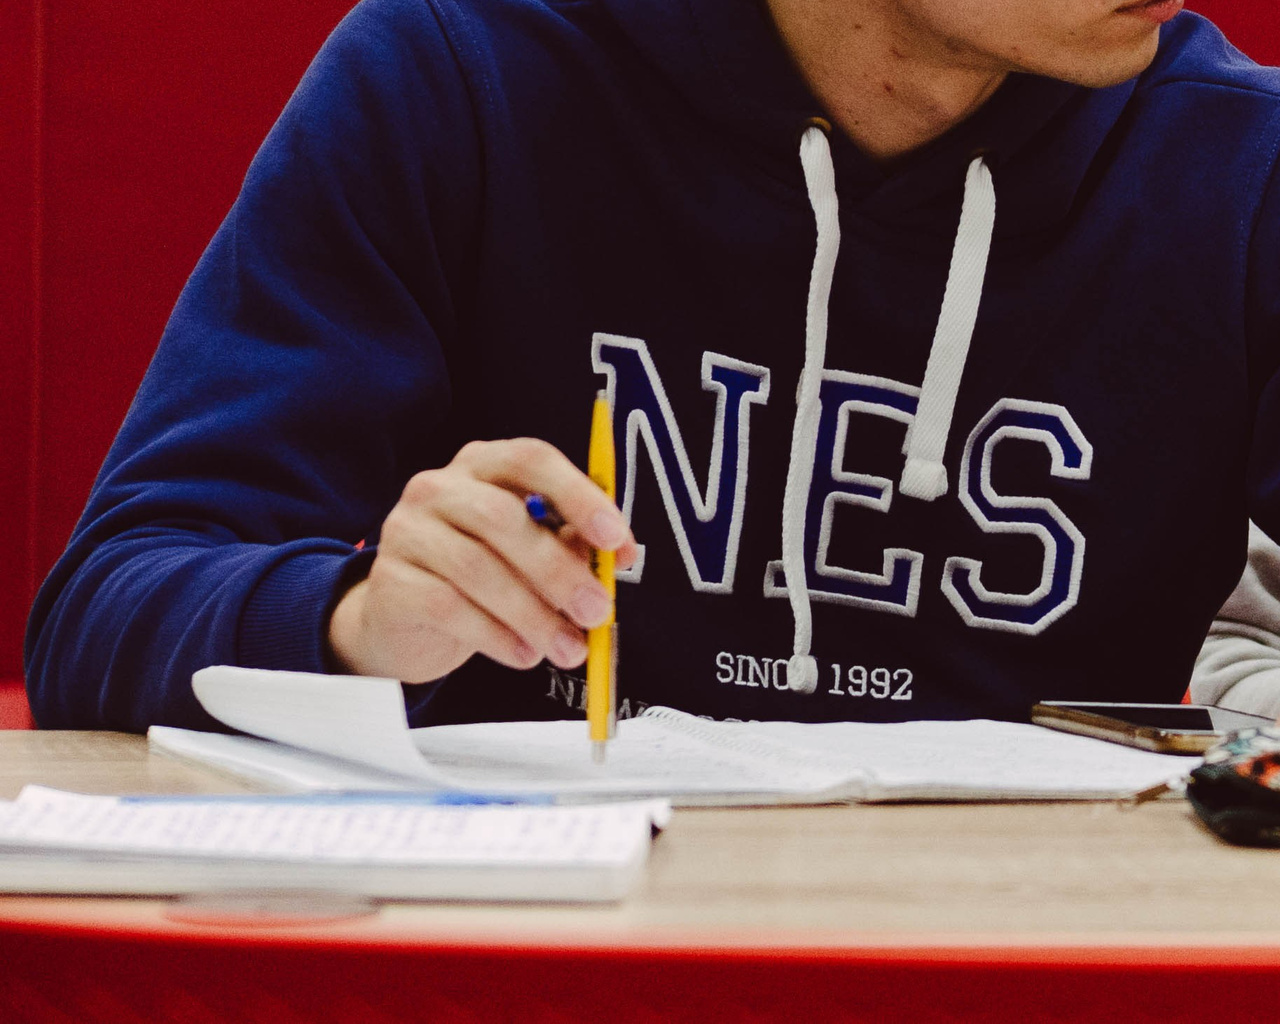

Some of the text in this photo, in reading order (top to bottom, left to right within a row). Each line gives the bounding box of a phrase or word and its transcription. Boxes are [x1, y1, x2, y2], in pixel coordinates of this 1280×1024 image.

[591, 332, 1094, 636] NES
[715, 651, 914, 701] SINC 1992
